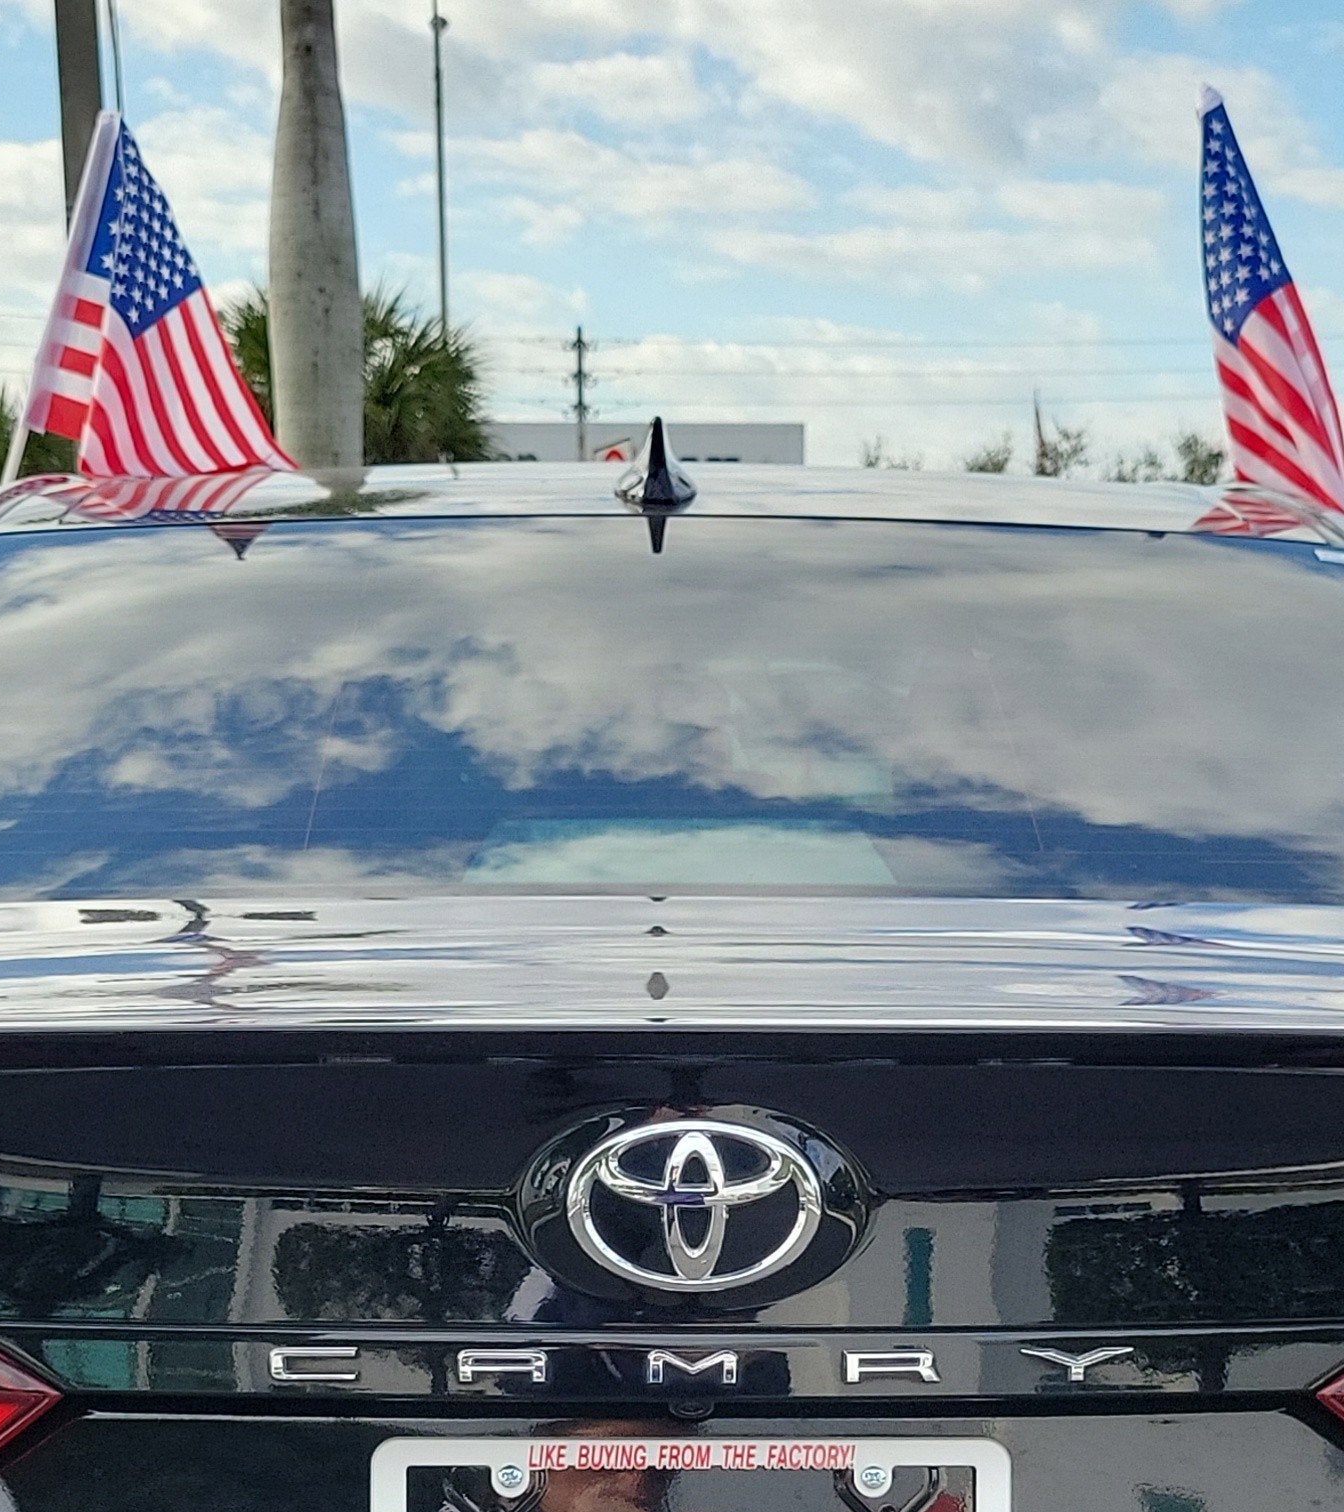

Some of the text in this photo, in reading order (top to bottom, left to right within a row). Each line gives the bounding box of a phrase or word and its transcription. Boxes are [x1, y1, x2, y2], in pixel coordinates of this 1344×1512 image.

[268, 1346, 1134, 1384] CAMRY
[529, 1444, 856, 1468] LIKE BUYING FROM THE FACTORY!
